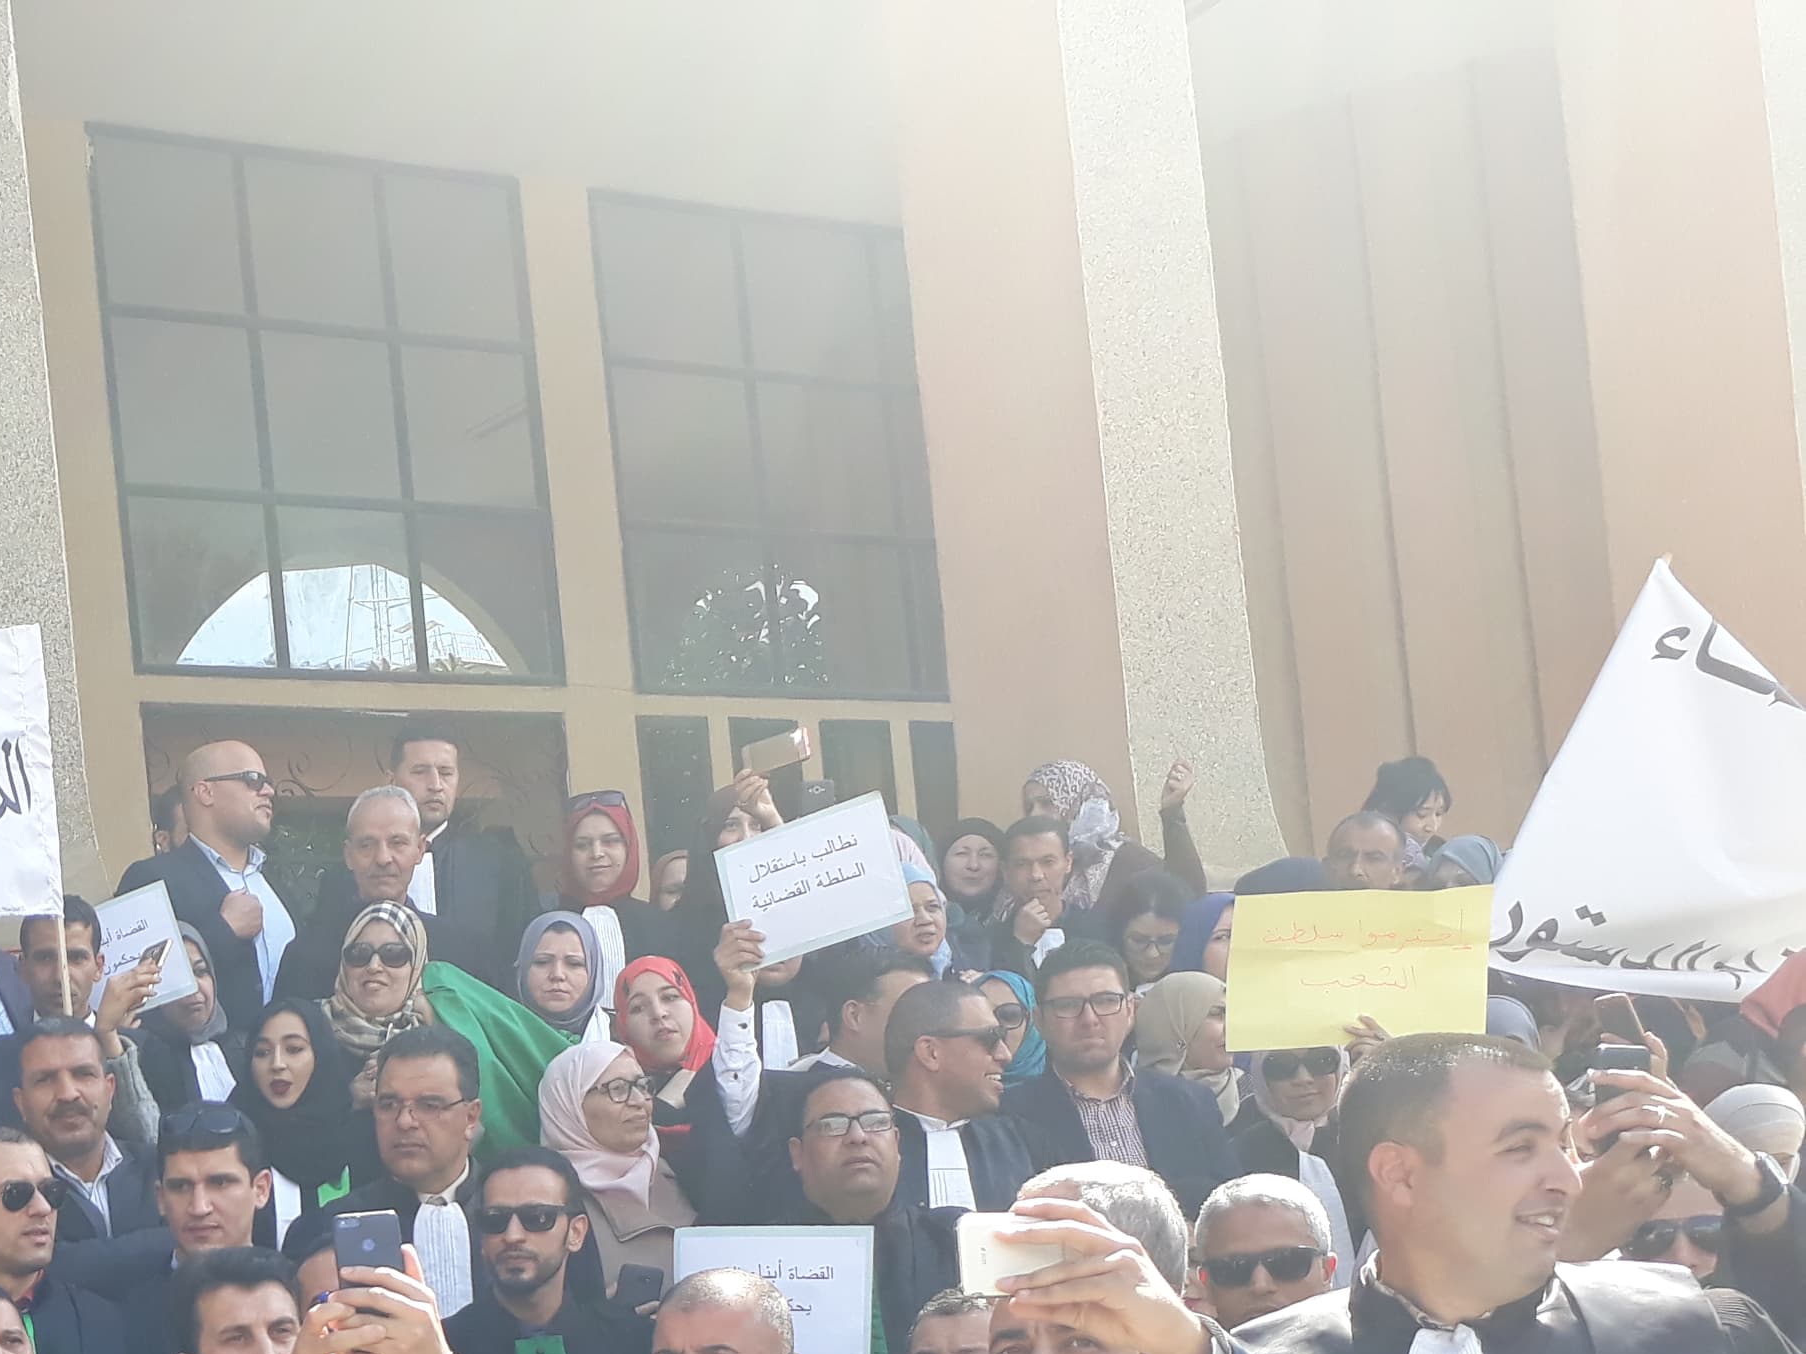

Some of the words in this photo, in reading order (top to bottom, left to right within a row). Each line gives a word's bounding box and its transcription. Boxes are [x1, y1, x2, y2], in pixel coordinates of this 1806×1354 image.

[810, 833, 859, 862] نطالب
[748, 851, 808, 884] باستقلال
[816, 862, 867, 889] السلطة
[751, 879, 811, 913] القضائية
[114, 919, 149, 941] القضاة
[1300, 964, 1417, 995] الشعب
[788, 1266, 834, 1280] القضاة
